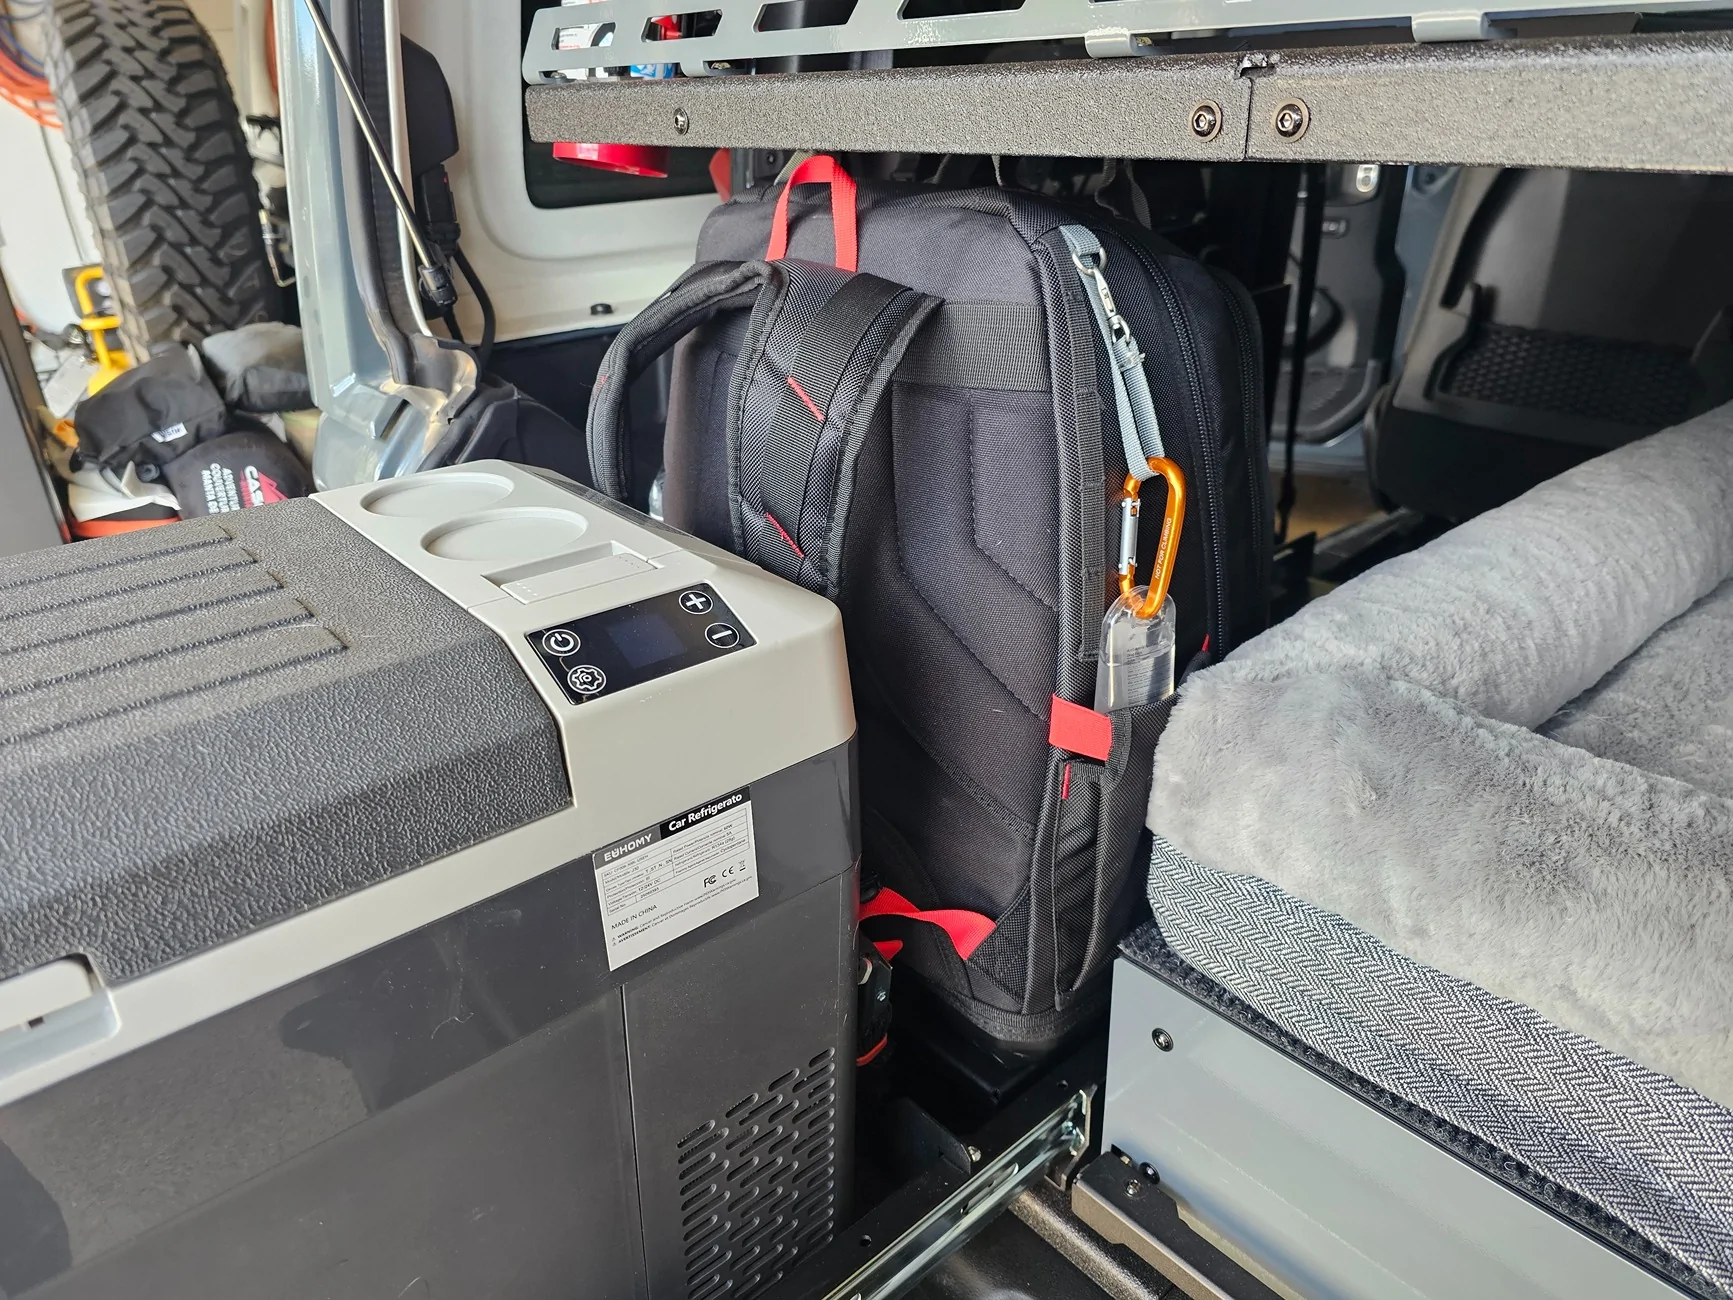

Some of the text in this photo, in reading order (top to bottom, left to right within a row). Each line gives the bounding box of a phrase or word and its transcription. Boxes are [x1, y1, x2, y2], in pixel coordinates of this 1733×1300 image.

[244, 466, 264, 506] CAS
[1161, 518, 1172, 550] CLIMBING
[668, 794, 742, 831] Car Refrigerato
[611, 917, 628, 930] MADE
[638, 904, 657, 917] CHINA
